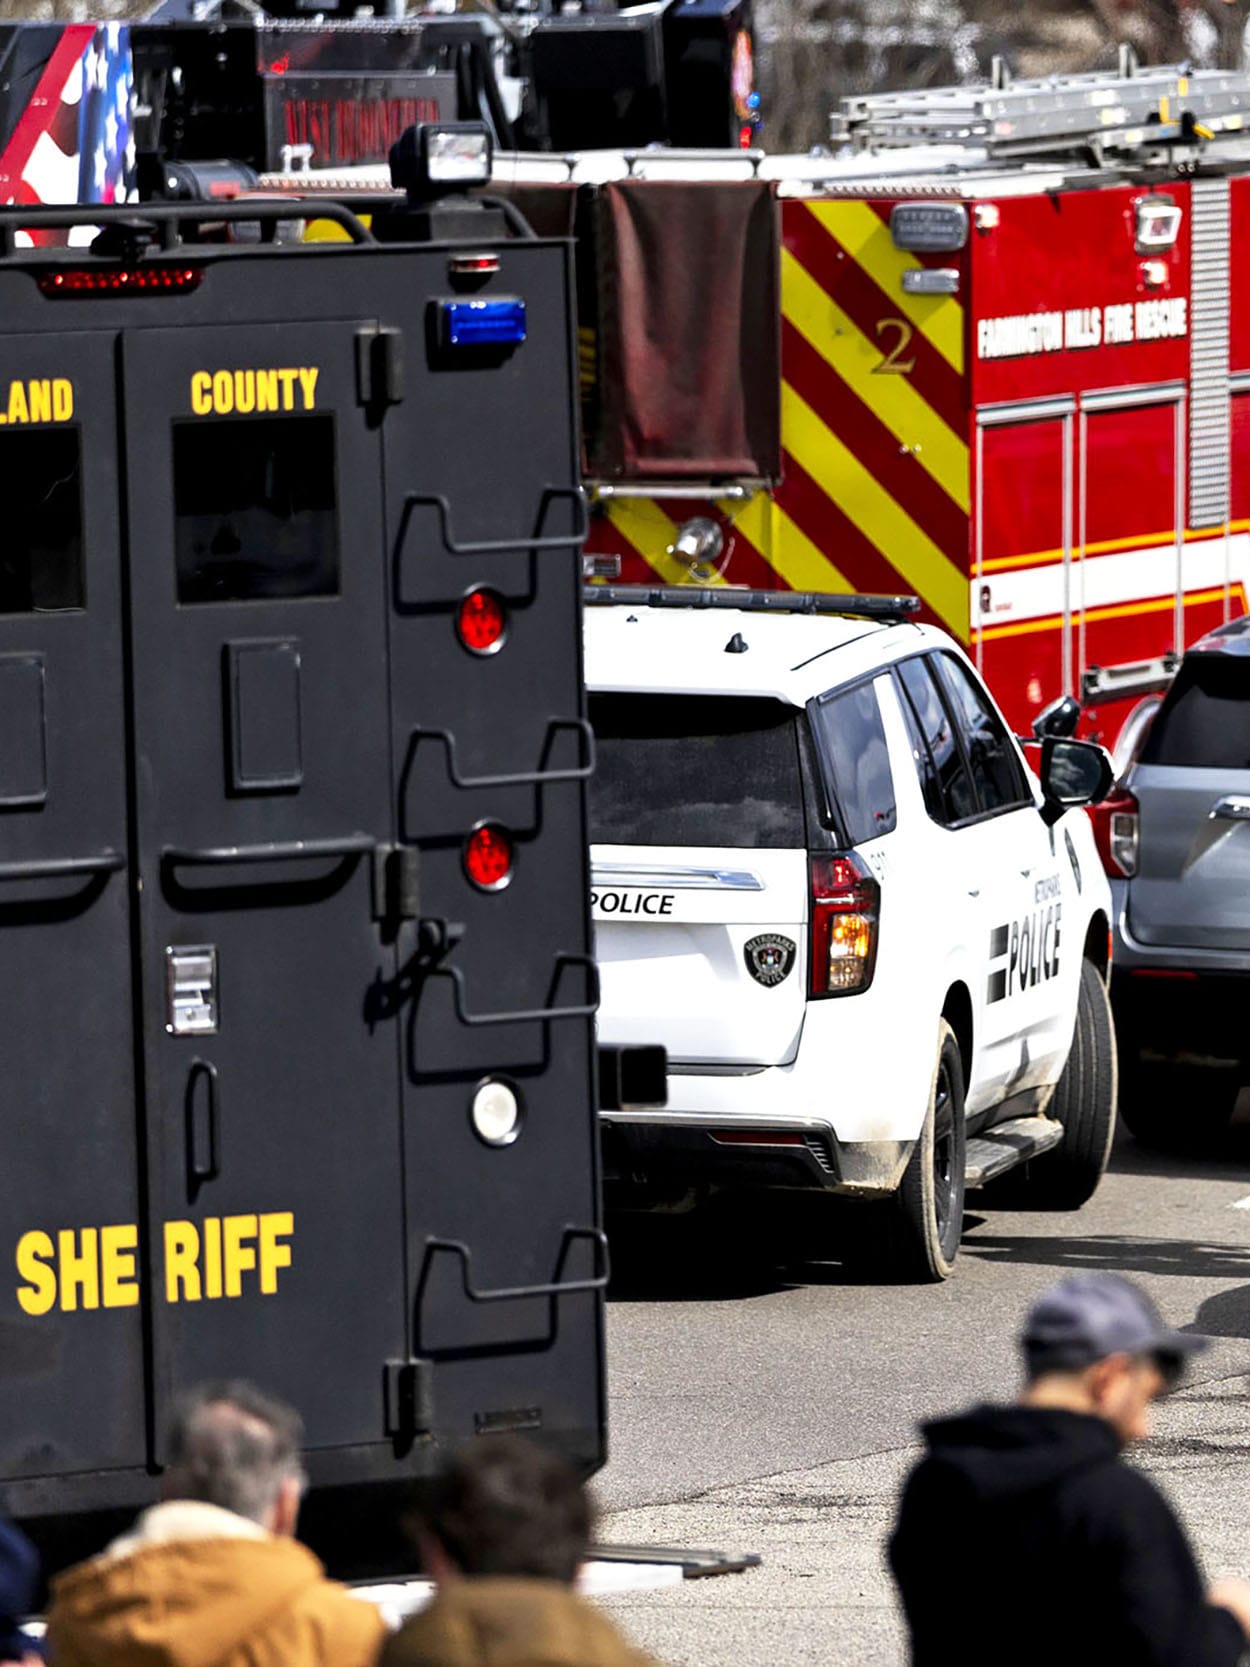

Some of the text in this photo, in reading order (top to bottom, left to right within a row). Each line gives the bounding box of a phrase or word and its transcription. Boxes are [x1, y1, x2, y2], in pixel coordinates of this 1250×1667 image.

[870, 317, 916, 375] 2
[191, 366, 319, 416] COUNTY
[1008, 902, 1062, 997] POLICE
